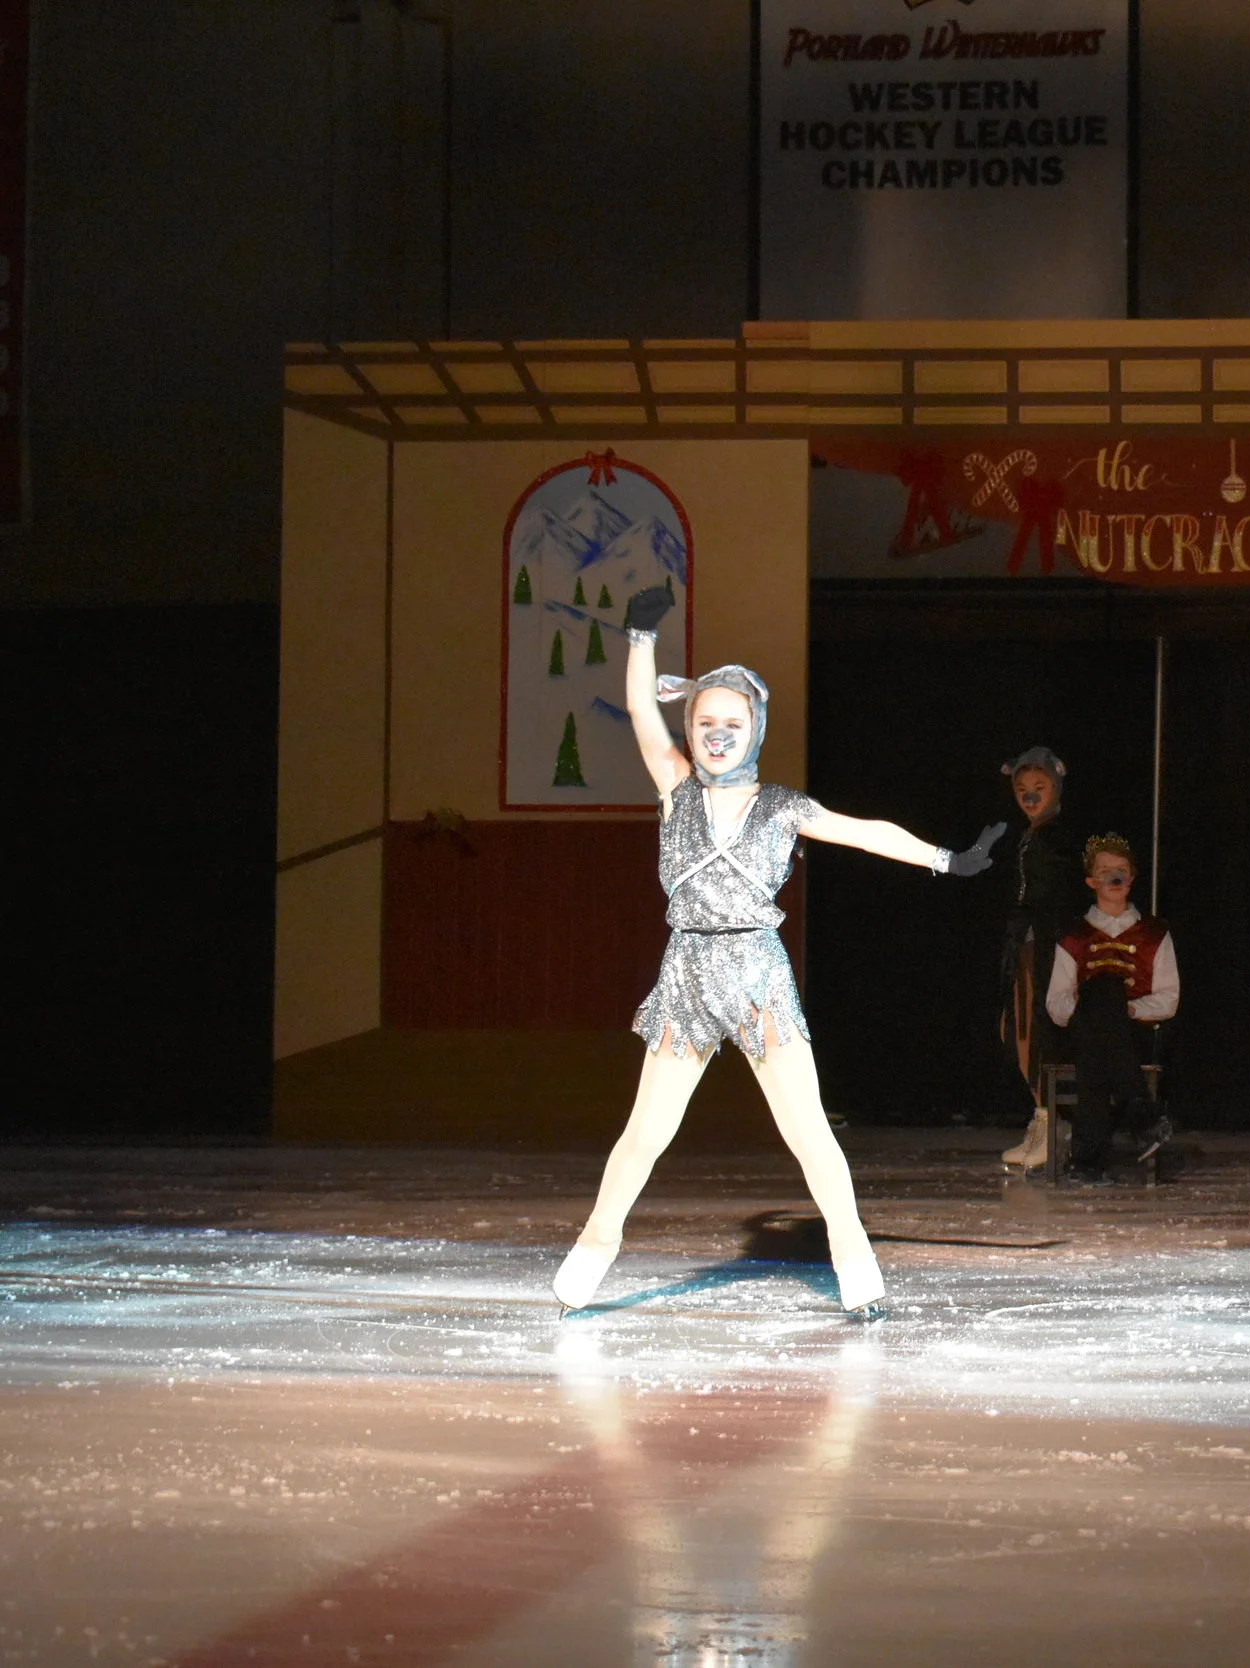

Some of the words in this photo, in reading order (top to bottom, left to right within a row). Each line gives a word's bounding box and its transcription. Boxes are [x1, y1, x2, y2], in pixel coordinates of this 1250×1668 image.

[850, 79, 1040, 112] WESTERN
[780, 120, 943, 151] HOCKEY
[955, 116, 1107, 149] LEAGUE
[822, 156, 1065, 189] CHAMPIONS
[1086, 440, 1164, 492] the
